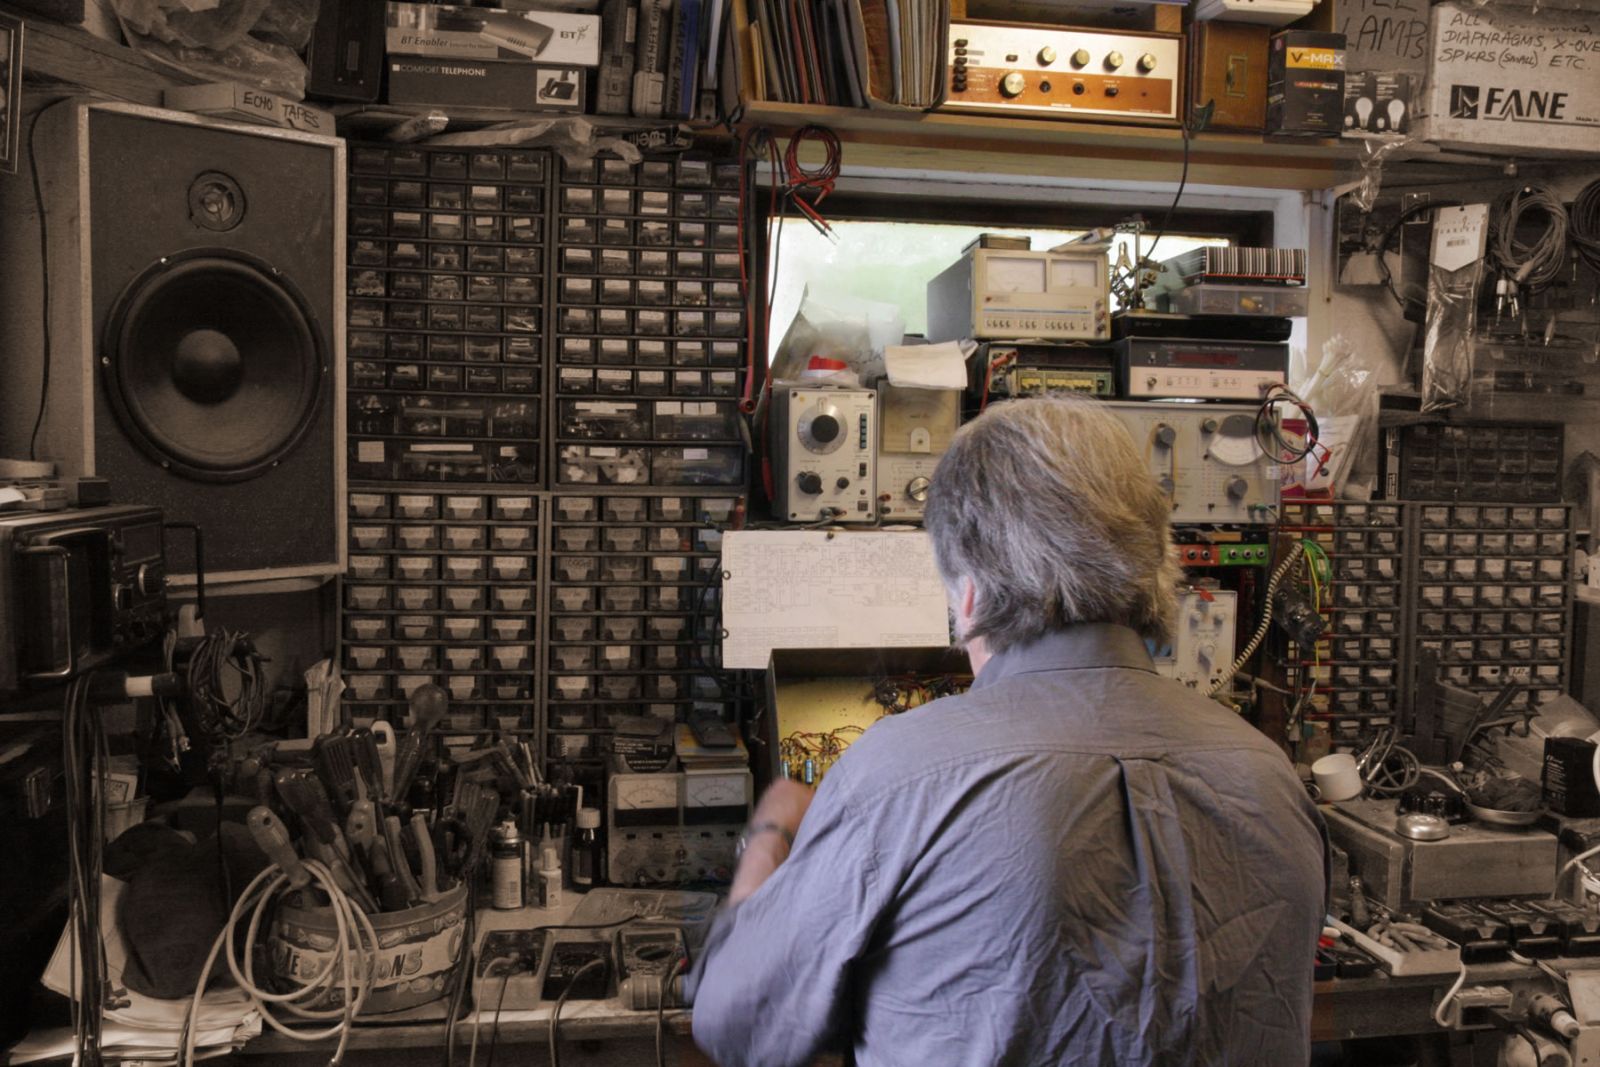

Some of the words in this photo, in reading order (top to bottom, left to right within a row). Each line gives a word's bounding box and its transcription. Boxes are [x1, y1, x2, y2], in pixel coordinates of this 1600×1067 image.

[1450, 13, 1481, 26] ALL
[401, 36, 412, 44] BT
[414, 37, 448, 47] Enabler
[560, 31, 577, 39] BT
[1291, 52, 1344, 65] V-MAX
[401, 64, 439, 73] COMFORT
[441, 66, 487, 76] TELEPHONE
[243, 91, 273, 111] ECHO
[282, 104, 320, 128] TAPES
[1484, 87, 1569, 120] FANE
